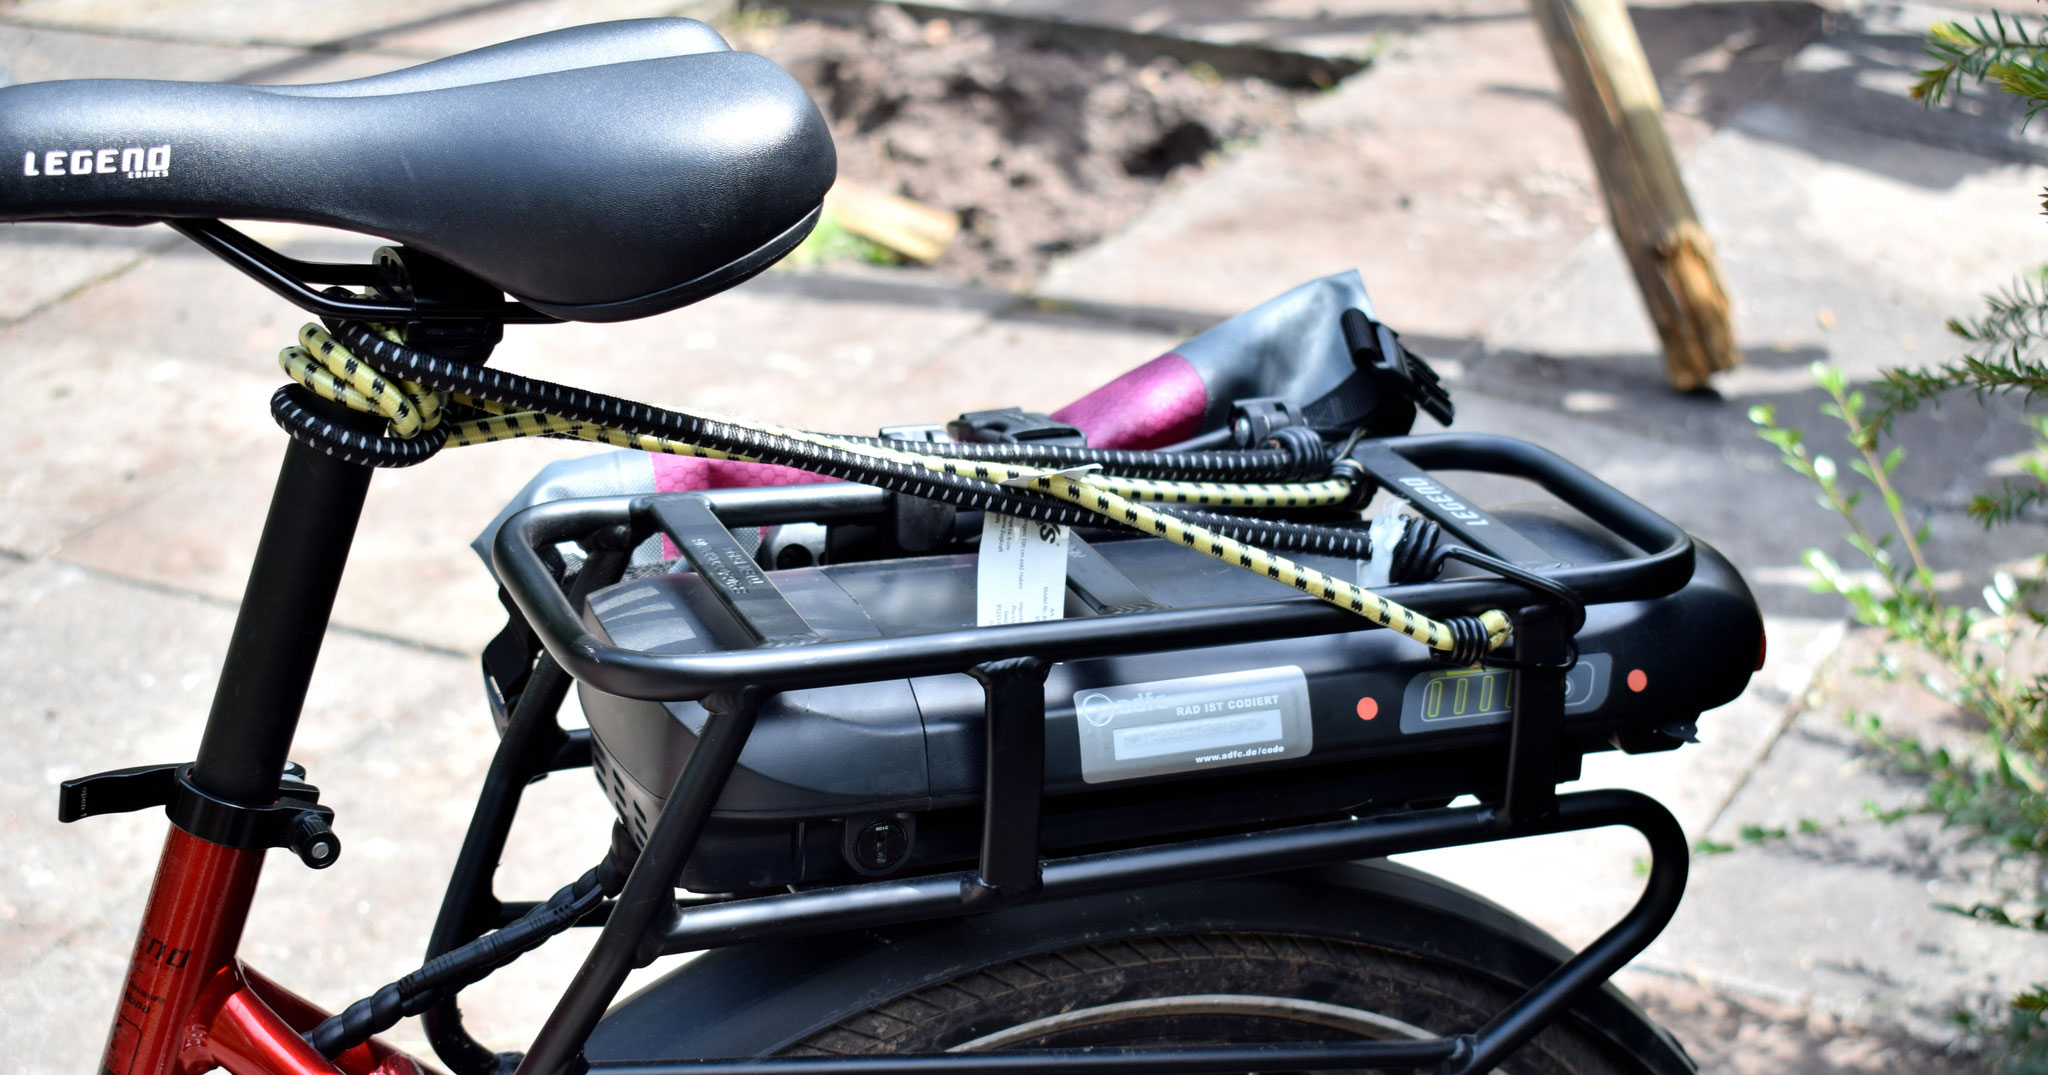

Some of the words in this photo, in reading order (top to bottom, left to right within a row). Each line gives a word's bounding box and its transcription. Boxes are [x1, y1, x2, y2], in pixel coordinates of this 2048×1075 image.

[24, 145, 171, 176] LEGEND
[1398, 476, 1490, 527] LEGEND
[997, 529, 1005, 553] Zugkraft
[1006, 542, 1011, 551] cm
[1020, 549, 1025, 558] cm
[1115, 691, 1170, 715] adfc
[1176, 704, 1201, 717] RAD
[1204, 701, 1225, 713] IST
[1227, 695, 1281, 711] CODIERT
[1194, 745, 1285, 764] www.adfc.de/code
